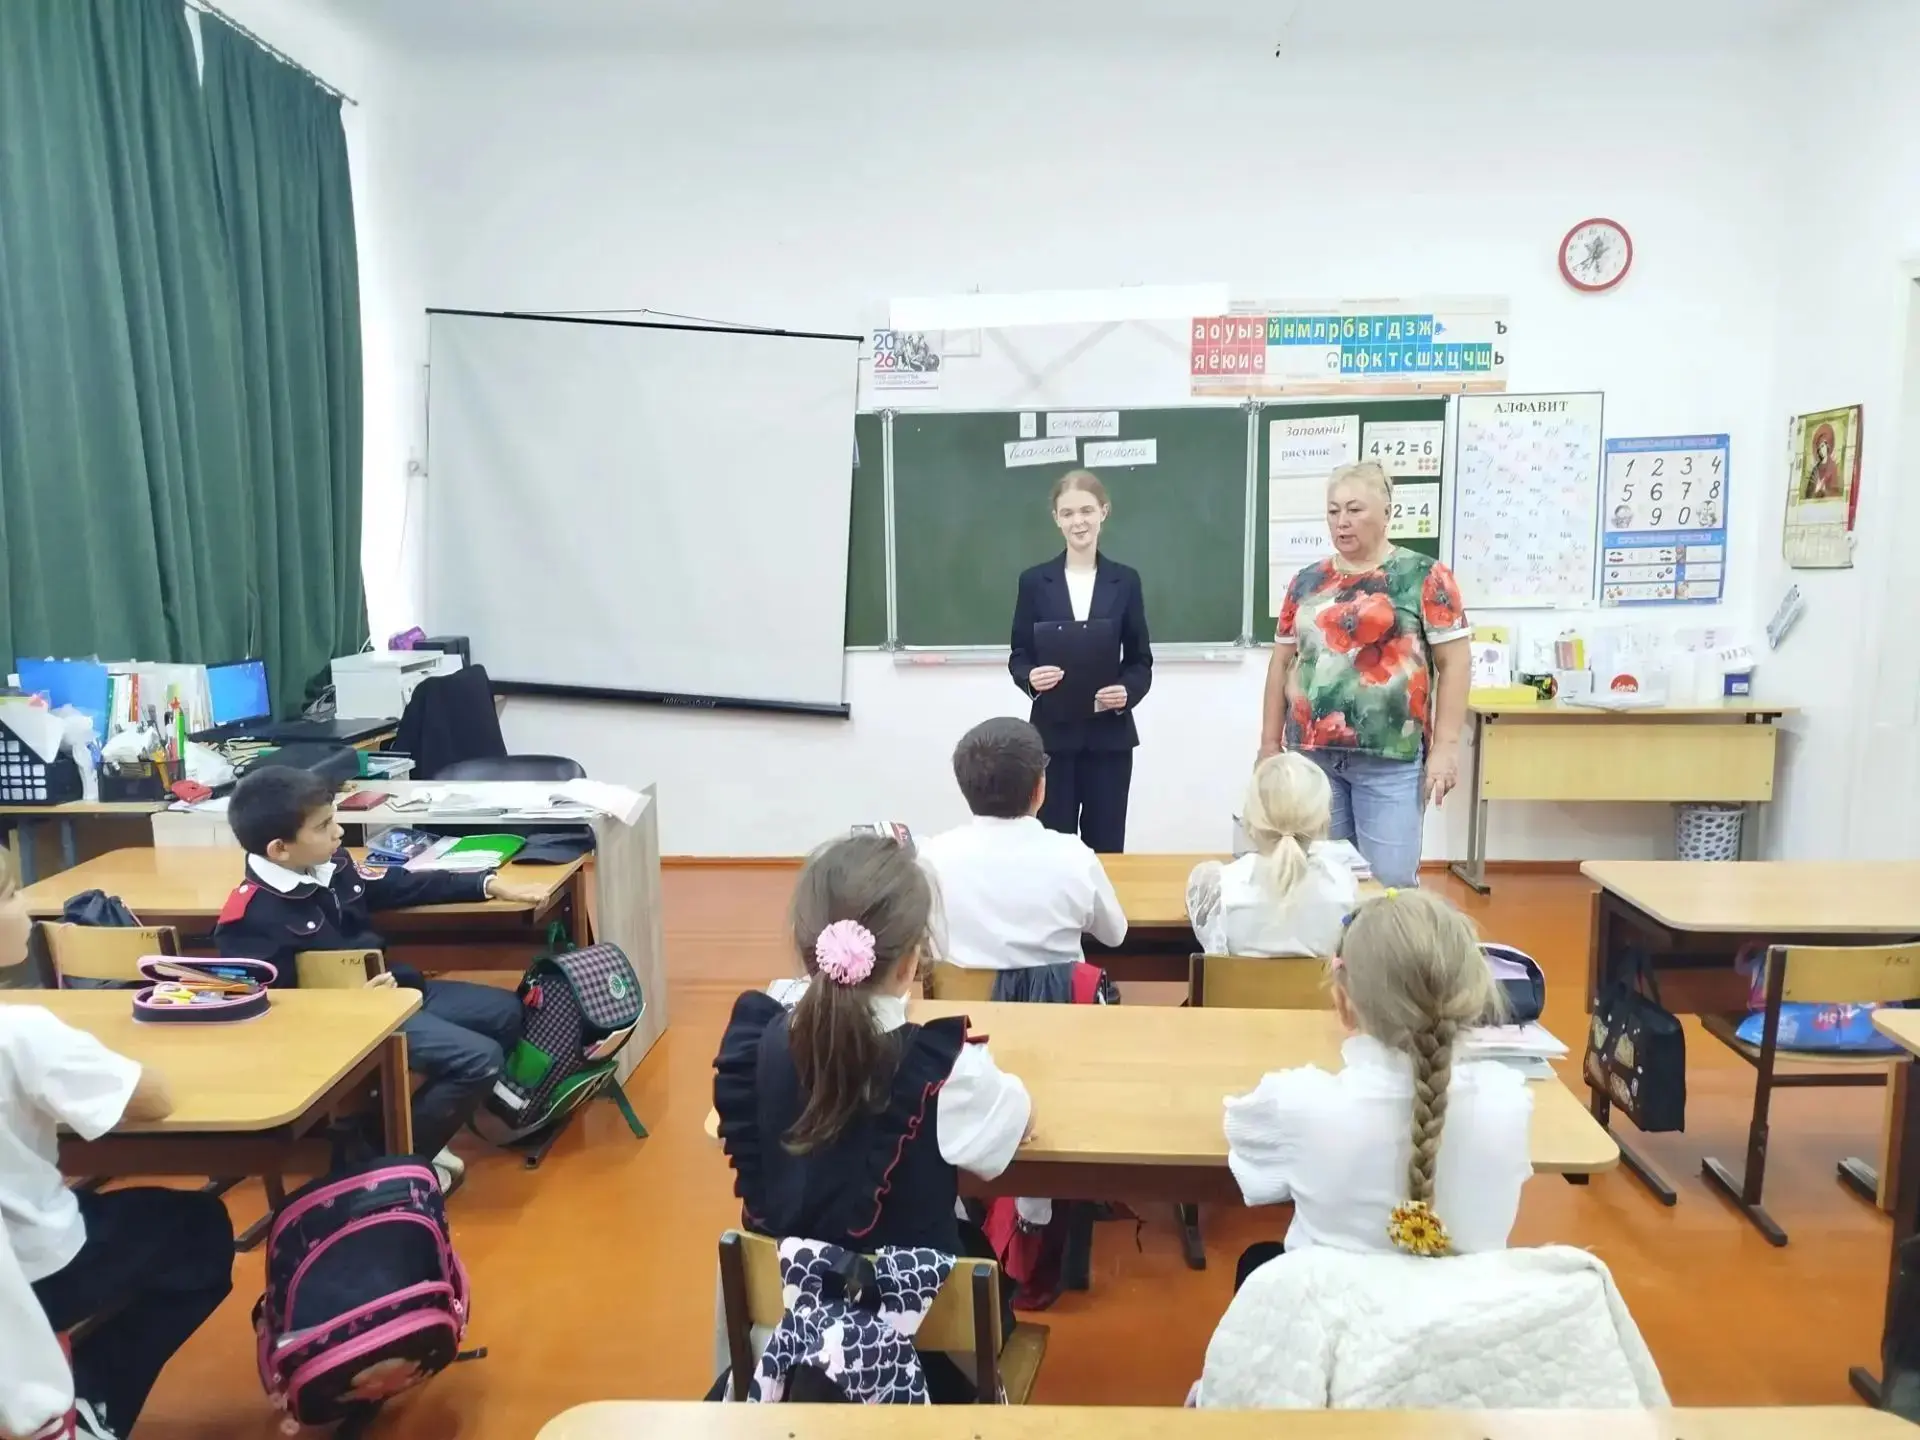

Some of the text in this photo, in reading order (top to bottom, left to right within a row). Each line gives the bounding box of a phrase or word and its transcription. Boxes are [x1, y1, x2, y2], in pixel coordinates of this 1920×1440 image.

[873, 333, 895, 350] 20
[874, 351, 896, 368] 26
[1494, 400, 1569, 414] АЛФАВИТ
[1286, 423, 1346, 437] Запомни!
[1281, 448, 1331, 461] рисунок
[1370, 440, 1380, 456] 4
[1395, 440, 1406, 456] 2
[1423, 440, 1433, 455] 6
[1625, 455, 1722, 478] 1 2 3 4
[1621, 480, 1721, 502] 5 6 7 8
[1393, 503, 1403, 518] 2
[1419, 502, 1430, 518] 4
[1649, 507, 1663, 525] 9
